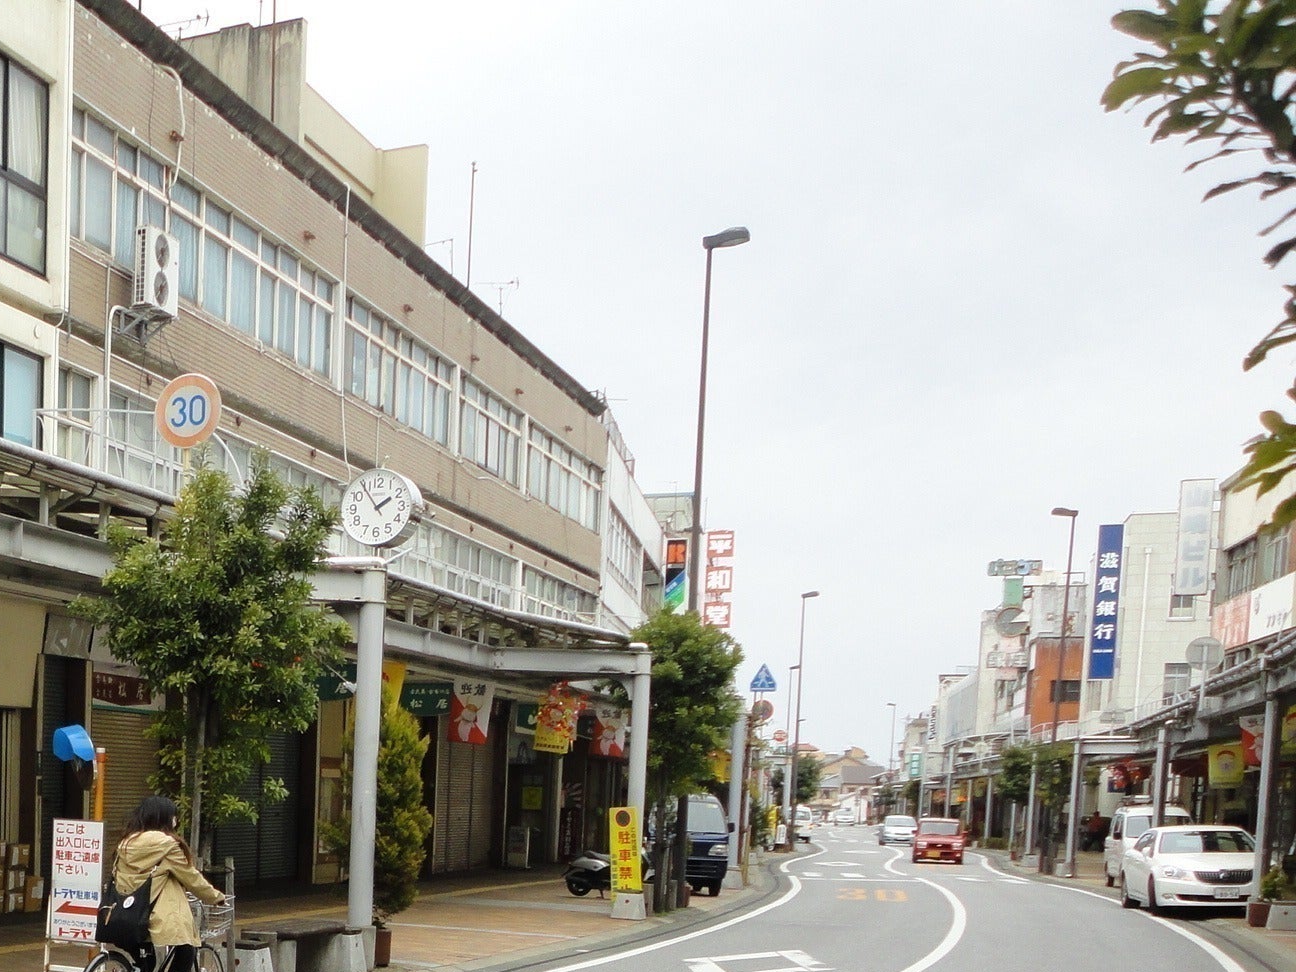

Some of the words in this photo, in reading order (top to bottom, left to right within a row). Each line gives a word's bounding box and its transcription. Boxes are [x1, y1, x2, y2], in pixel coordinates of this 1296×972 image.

[171, 394, 206, 428] 30
[373, 477, 384, 489] 12
[389, 479, 393, 490] 1
[350, 490, 364, 502] 10
[395, 487, 403, 499] 2
[349, 503, 358, 515] 9
[397, 500, 406, 511] 3
[352, 515, 361, 526] 8
[393, 513, 401, 524] 4
[362, 524, 370, 536] 7
[372, 526, 380, 538] 6
[384, 522, 392, 534] 5
[706, 533, 734, 626] 平和堂
[1093, 552, 1120, 640] 滋賀銀行
[56, 823, 85, 835] ここは
[55, 837, 100, 850] 出入口に付
[55, 850, 100, 864] 駐車ご遠慮
[55, 863, 89, 876] 下さい。
[54, 888, 99, 901] トラヤ駐車場
[58, 927, 92, 940] トラヤ
